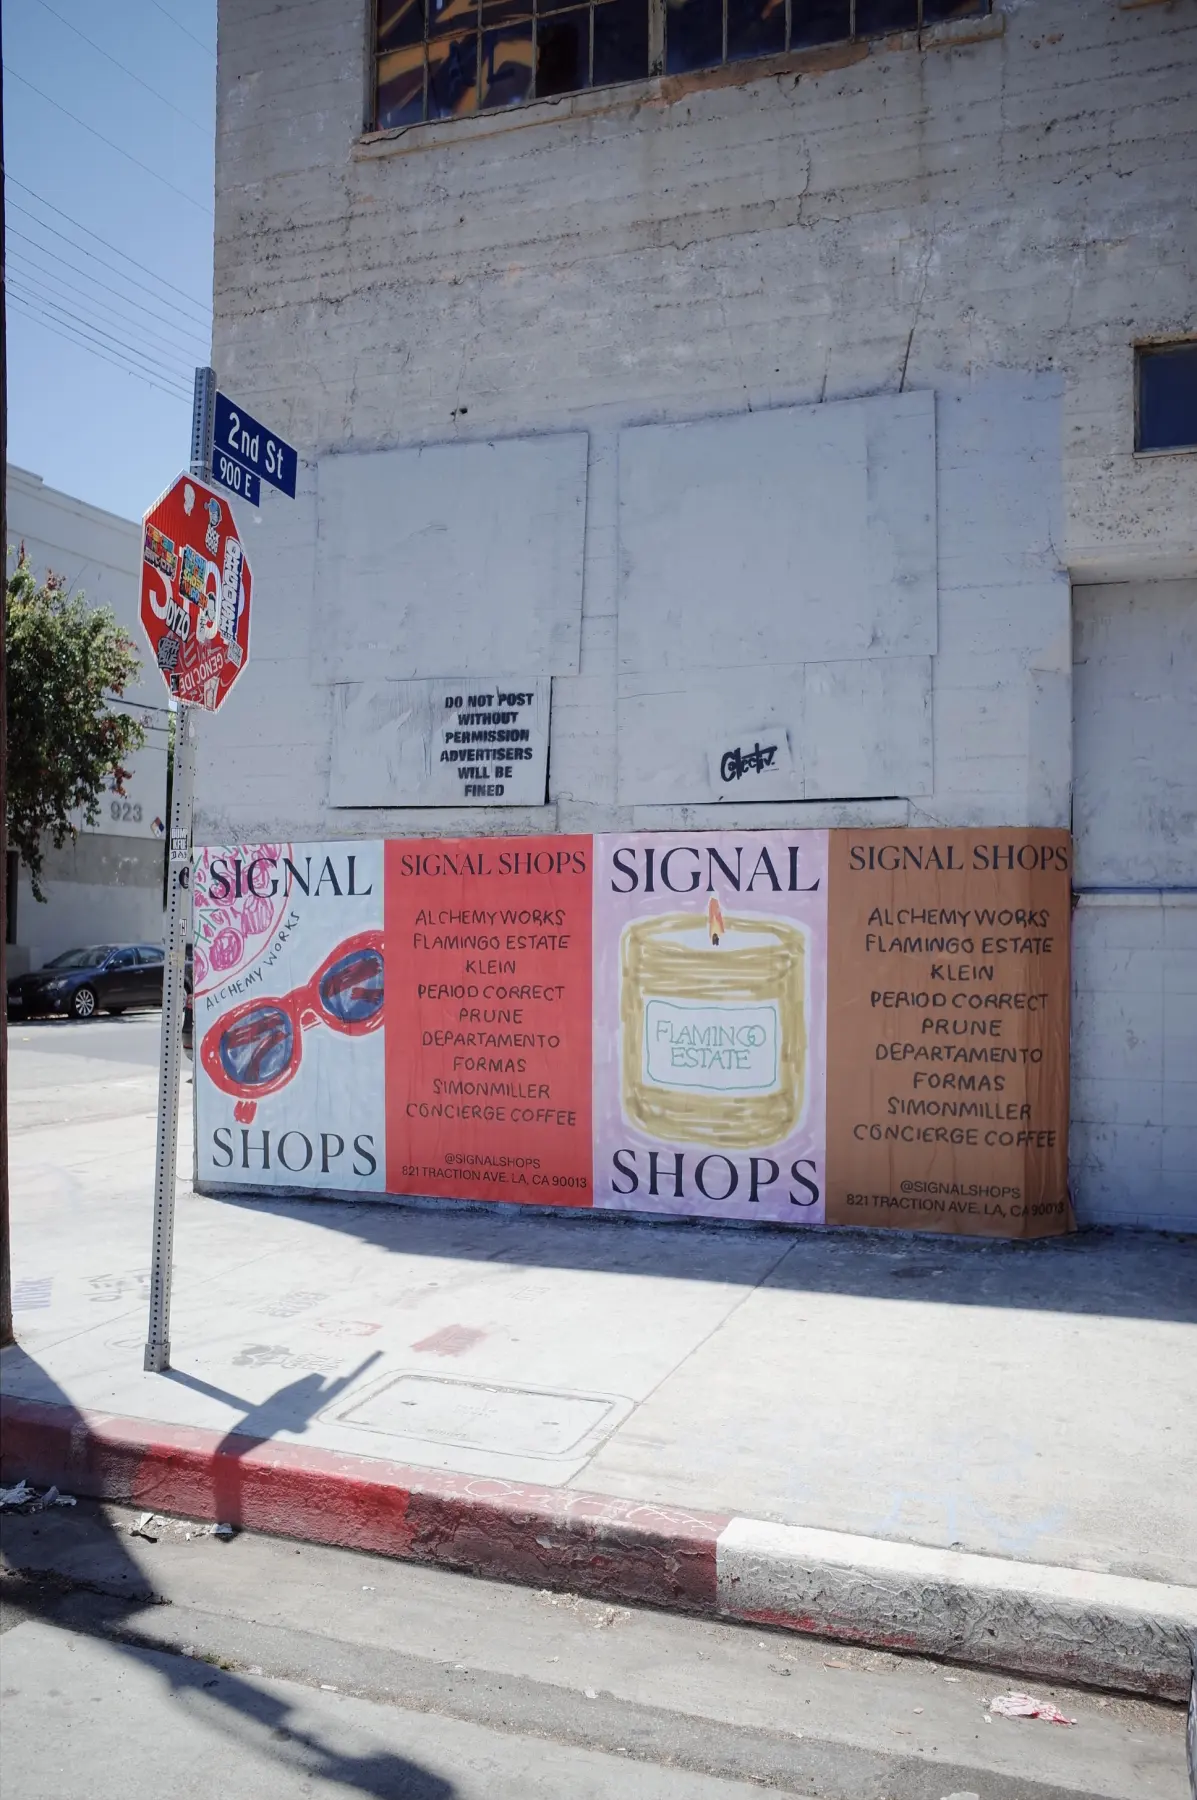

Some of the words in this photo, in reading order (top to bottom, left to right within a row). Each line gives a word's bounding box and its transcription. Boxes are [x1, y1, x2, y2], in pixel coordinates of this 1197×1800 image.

[227, 412, 260, 463] 2nd
[265, 440, 284, 480] St
[219, 457, 241, 490] 900
[244, 473, 252, 498] E
[180, 653, 224, 695] GENOCIDE
[445, 695, 463, 709] DO
[467, 694, 495, 708] NOT
[497, 693, 535, 706] POST
[457, 711, 519, 726] WITHOUT
[445, 729, 530, 744] PERMISSION
[440, 747, 533, 762] ADVERTISERS
[457, 766, 491, 780] WILL
[495, 766, 513, 778] BE
[464, 784, 505, 797] FINED
[110, 801, 143, 823] 923
[401, 853, 492, 877] SIGNAL
[498, 851, 587, 875] SHOPS
[850, 844, 964, 871] SIGNAL
[972, 844, 1069, 871] SHOPS
[208, 855, 373, 900] SIGNAL
[611, 846, 821, 893] SIGNAL
[415, 909, 498, 926] ALCHEMY
[499, 909, 566, 927] WORKS
[867, 907, 971, 927] ALCHEMY
[974, 909, 1050, 928] WORKS
[413, 933, 500, 950] FLAMINGO
[506, 934, 571, 951] ESTATE
[865, 933, 975, 954] FLAMINGO
[982, 937, 1054, 955] ESTATE
[205, 968, 264, 1011] ALCHEMY
[263, 911, 300, 966] WORKS
[465, 959, 516, 974] KLEIN
[930, 964, 994, 981] KLEIN
[417, 983, 479, 999] PERIOD
[483, 985, 566, 1001] CORRECT
[870, 990, 947, 1008] PERIOD
[952, 992, 1048, 1011] CORRECT
[459, 1007, 524, 1024] PRUNE
[655, 1020, 767, 1048] FLAMINGO
[921, 1018, 1003, 1037] PRUNE
[422, 1030, 561, 1048] DEPARTAMENTO
[670, 1047, 752, 1070] ESTATE
[875, 1042, 1043, 1064] DEPARTAMENTO
[453, 1056, 528, 1073] FORMAS
[433, 1078, 550, 1099] SIMONMILLER
[913, 1071, 1006, 1092] FORMAS
[406, 1103, 505, 1121] CONCIERGE
[510, 1108, 577, 1126] COFFEE
[888, 1096, 1032, 1120] SIMONMILLER
[853, 1123, 979, 1146] CONCIERGE
[984, 1130, 1057, 1148] COFFEE
[211, 1127, 377, 1177] SHOPS
[444, 1153, 541, 1169] @SIGNALSHOPS
[402, 1166, 419, 1177] 821
[422, 1167, 481, 1181] TRACTION
[532, 1175, 550, 1187] CA
[551, 1176, 588, 1189] 90013
[611, 1149, 820, 1207] SHOPS
[900, 1179, 1021, 1199] @SIGNALSHOPS
[846, 1193, 868, 1206] 821
[871, 1195, 946, 1212] TRACTION
[1009, 1205, 1030, 1217] CA
